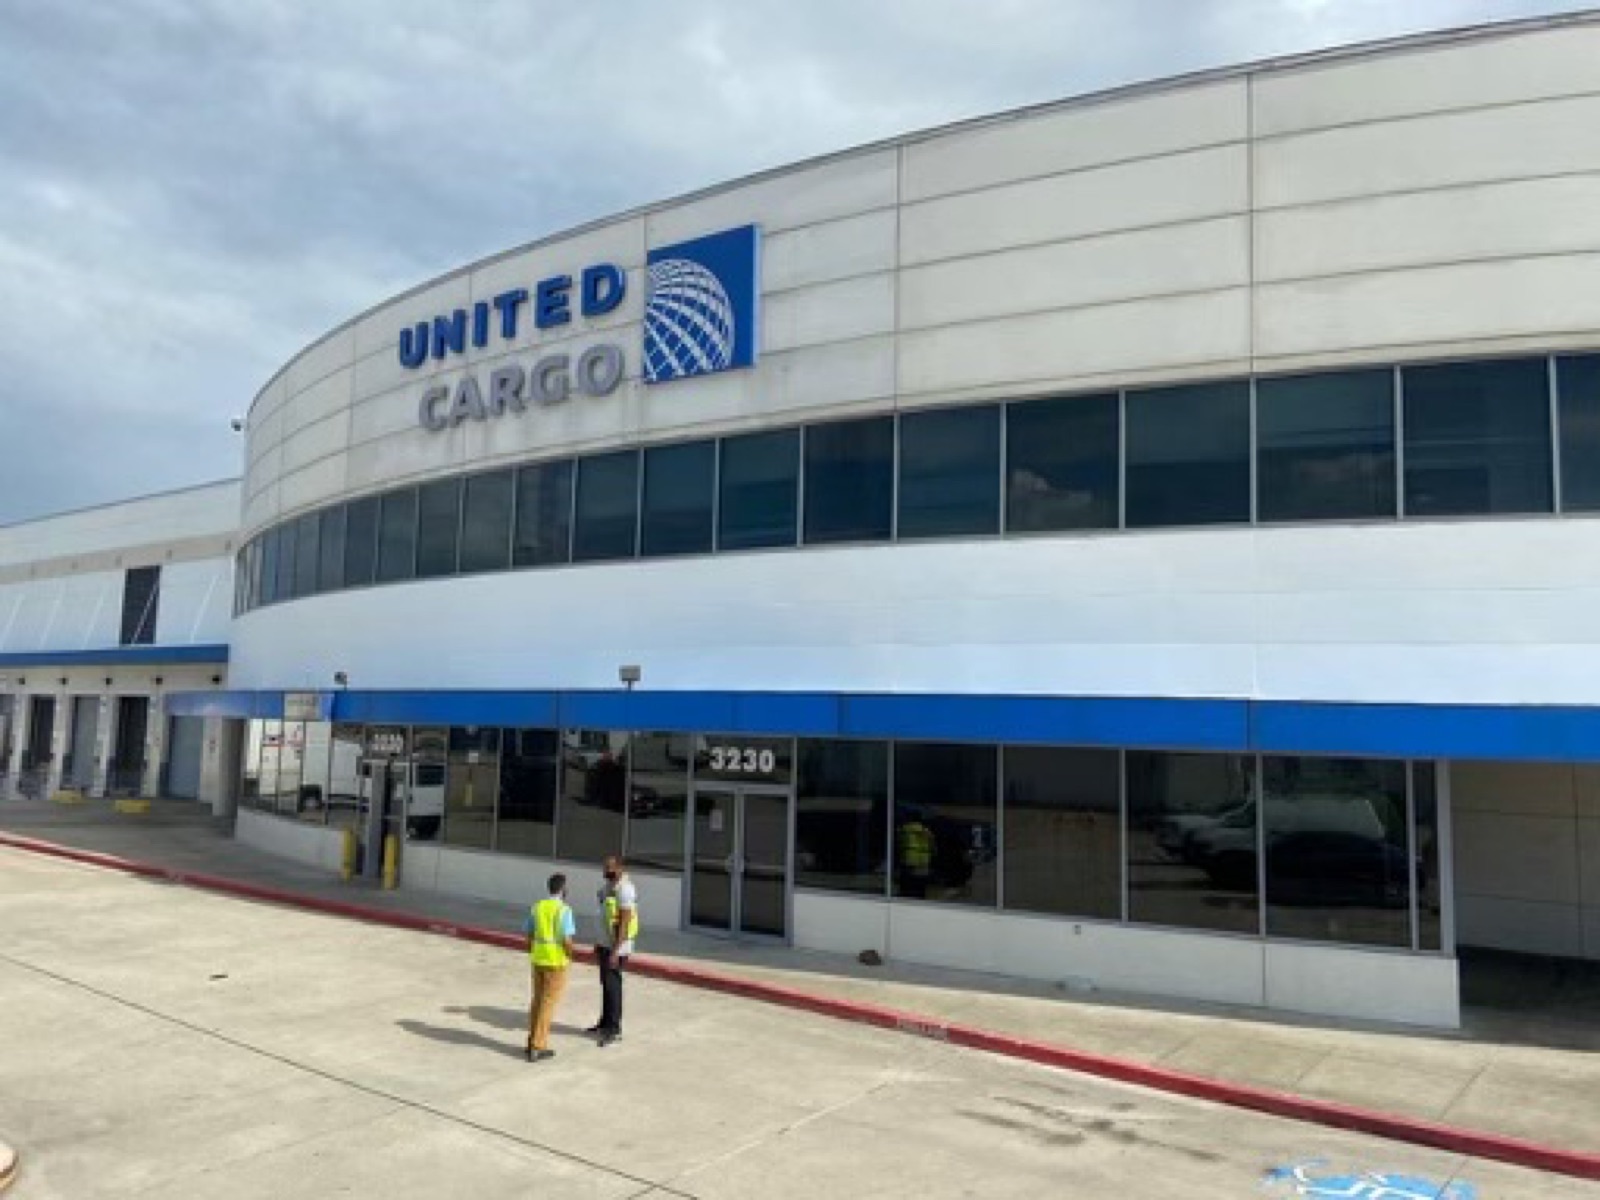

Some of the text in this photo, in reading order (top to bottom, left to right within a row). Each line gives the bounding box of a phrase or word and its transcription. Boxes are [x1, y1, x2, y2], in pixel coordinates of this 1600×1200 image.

[399, 262, 626, 369] UNITED
[418, 344, 624, 431] CARGO
[709, 747, 776, 773] 3230
